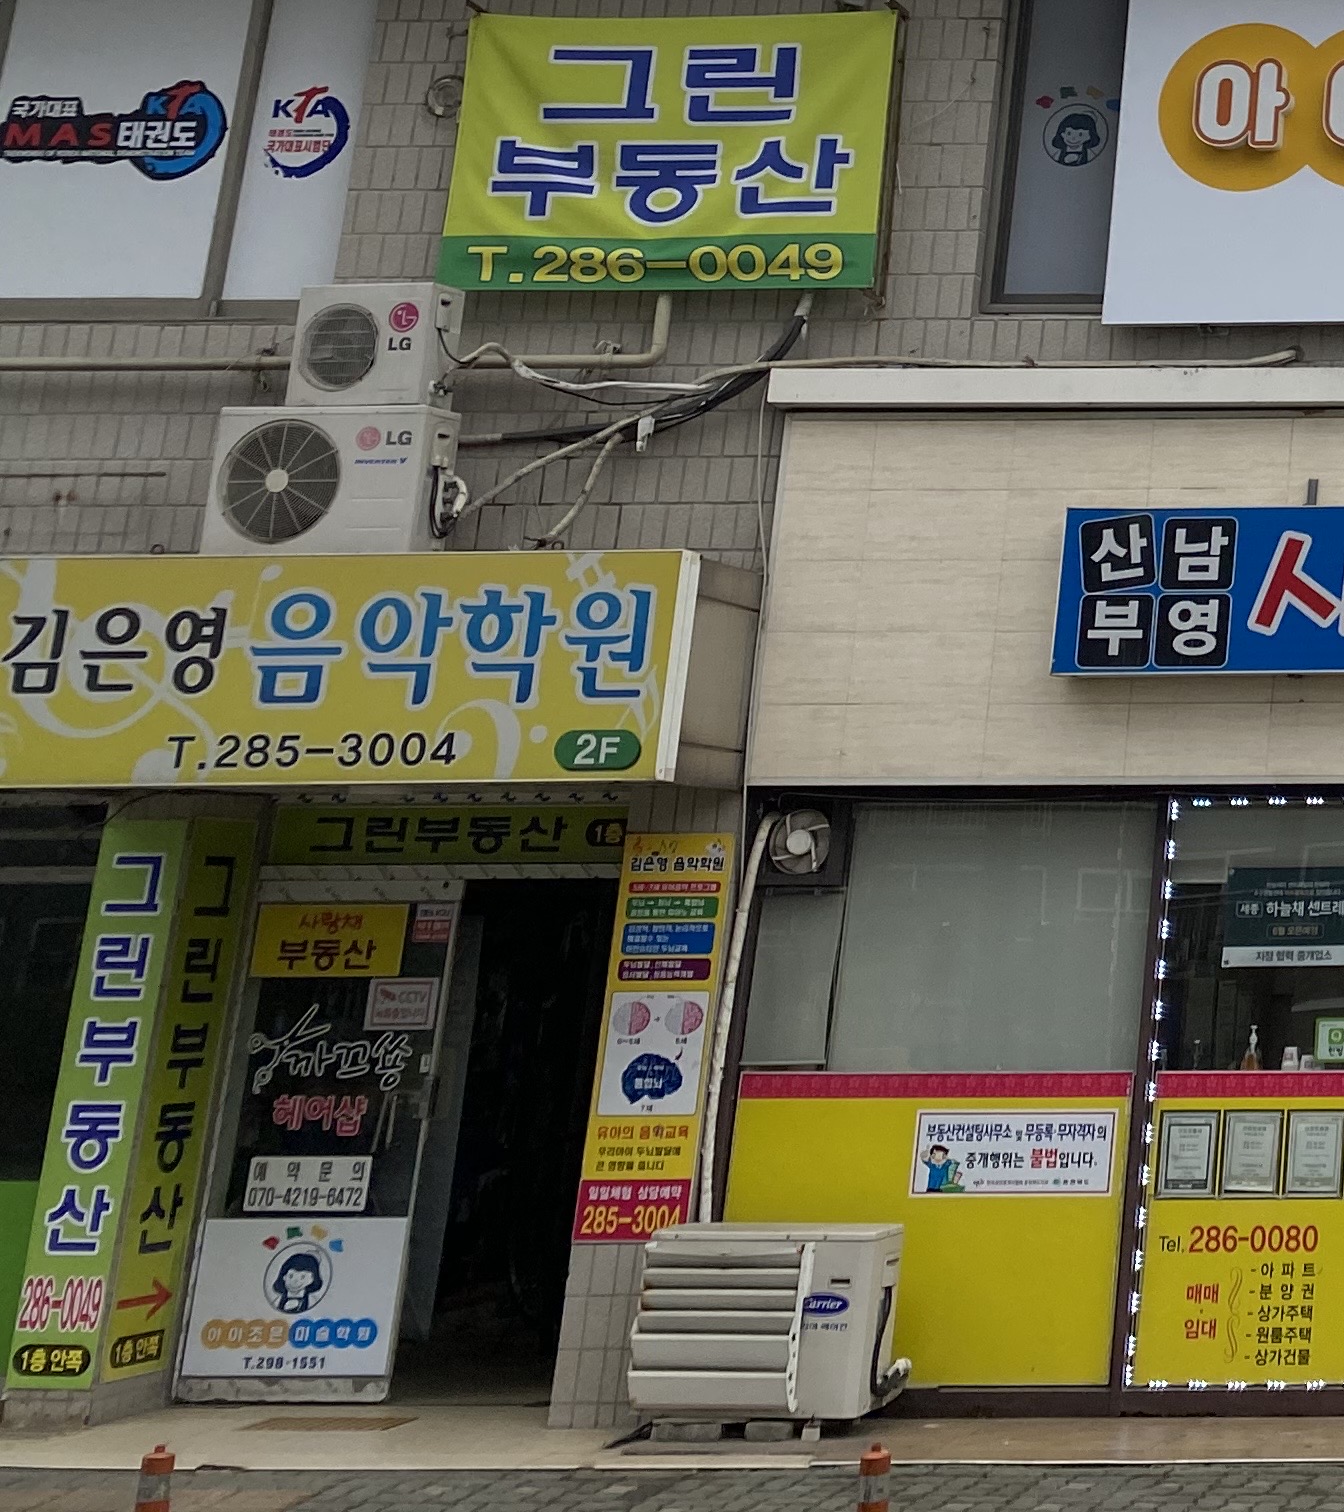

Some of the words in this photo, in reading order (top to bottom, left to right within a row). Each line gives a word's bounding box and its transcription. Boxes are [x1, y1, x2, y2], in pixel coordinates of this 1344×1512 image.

[540, 43, 800, 126] 그린
[11, 99, 80, 118] 국가대표
[147, 83, 203, 120] KTA
[272, 86, 332, 124] KTA
[4, 123, 112, 148] MAS
[116, 120, 197, 149] 태권도
[490, 135, 854, 226] 부동산
[468, 241, 844, 285] T.286-0049
[388, 337, 412, 351] LG
[385, 431, 413, 446] LG
[1090, 521, 1229, 582] 산남
[1086, 599, 1219, 656] 부영
[1, 606, 227, 695] 김은영
[249, 587, 656, 707] 음악학원
[167, 733, 458, 770] T.285-3004
[574, 735, 622, 765] 2F
[309, 816, 568, 854] 그린부동산
[631, 856, 669, 872] 김은영
[300, 911, 363, 935] 사랑채
[1266, 900, 1305, 918] 하늘채
[277, 939, 377, 972] 부동산
[44, 853, 168, 1256] 그린부동산
[138, 854, 236, 1255] 그린부동산
[273, 1094, 369, 1136] 헤어샵
[1188, 1225, 1319, 1254] 286-0080
[18, 1276, 104, 1331] 286-0049
[804, 1297, 844, 1311] Carrier
[1186, 1283, 1220, 1306] 매매
[1257, 1304, 1314, 1323] 상가주택
[1183, 1318, 1218, 1340] 임대
[1255, 1326, 1313, 1345] 원룸주택
[21, 1349, 46, 1372] 1층
[50, 1349, 83, 1373] 안쪽
[1254, 1348, 1311, 1367] 상가건물
